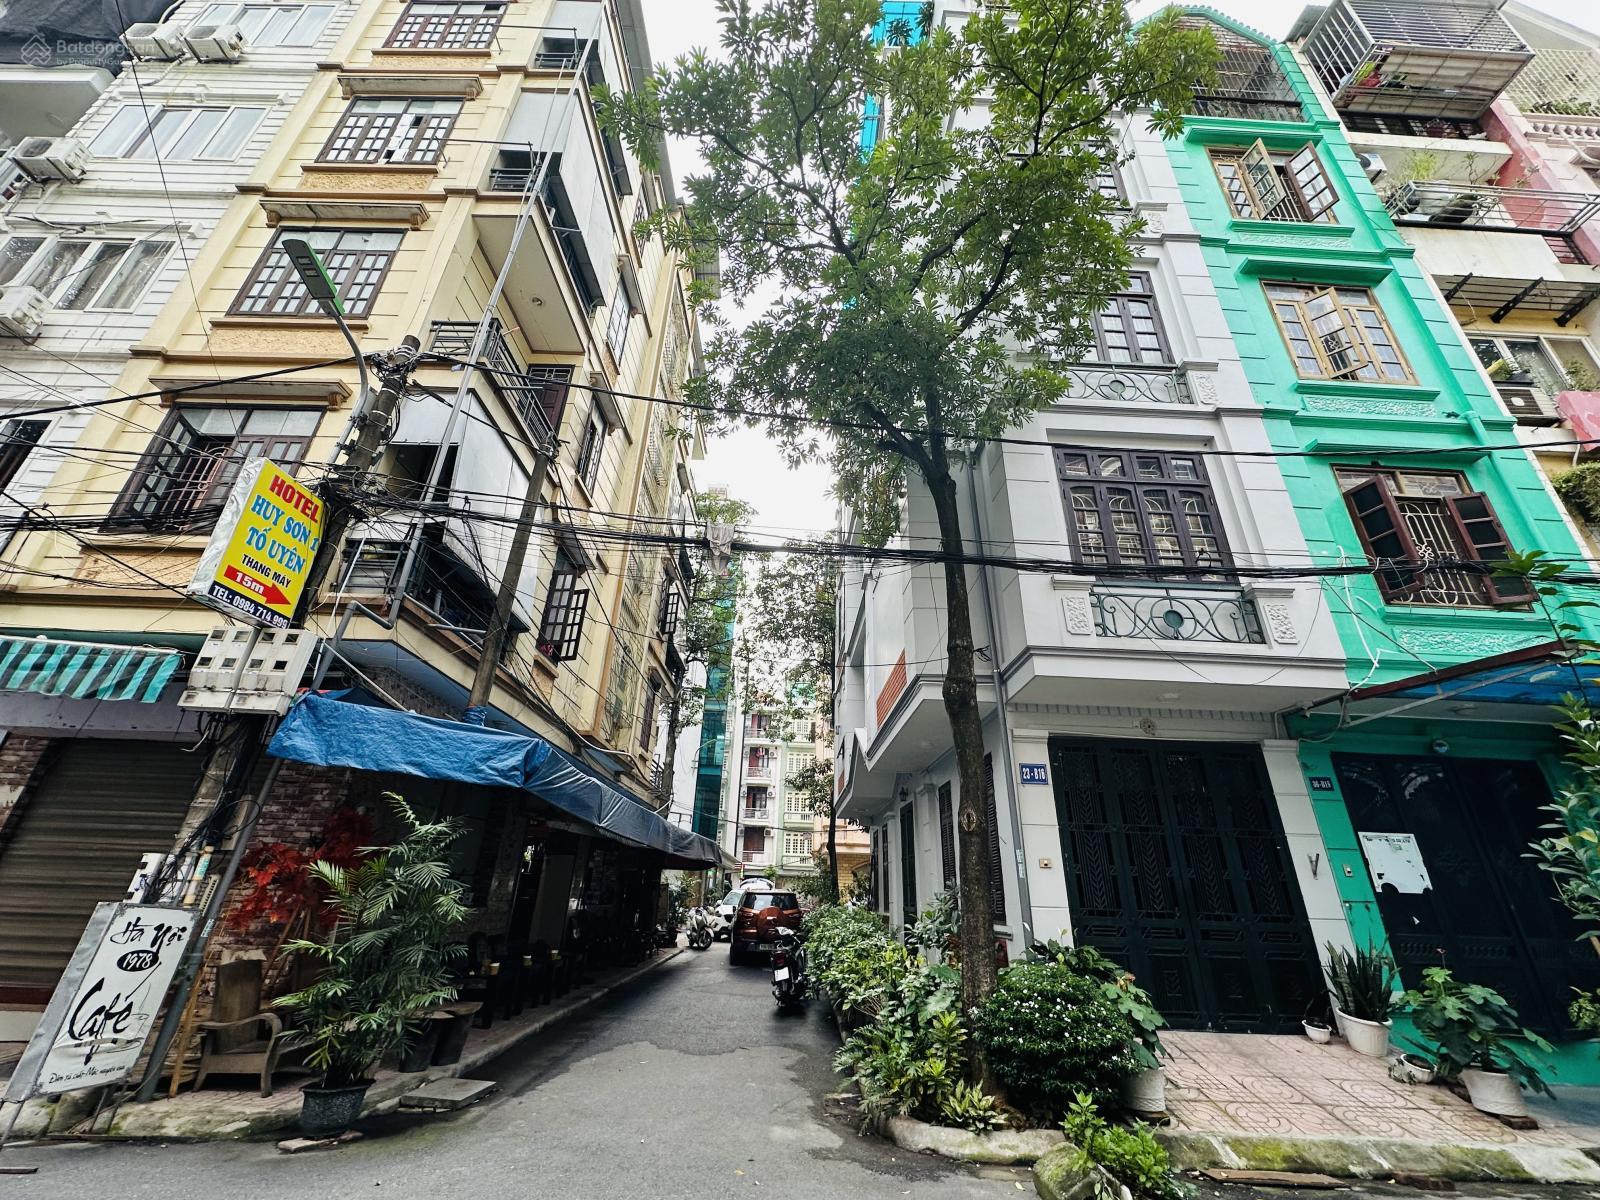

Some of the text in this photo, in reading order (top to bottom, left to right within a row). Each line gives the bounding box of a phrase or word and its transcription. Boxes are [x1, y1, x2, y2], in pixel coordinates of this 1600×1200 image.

[251, 495, 285, 527] HUY
[283, 516, 311, 544] SƠN
[269, 474, 320, 524] HOTEL
[241, 553, 292, 588] THANG MÁY
[246, 526, 306, 574] TỐ UYÊN
[235, 571, 265, 595] 15m
[212, 584, 289, 630] TEL: 0984 714 999
[110, 917, 153, 944] Hà
[122, 952, 153, 970] 1978
[67, 976, 135, 1066] Café
